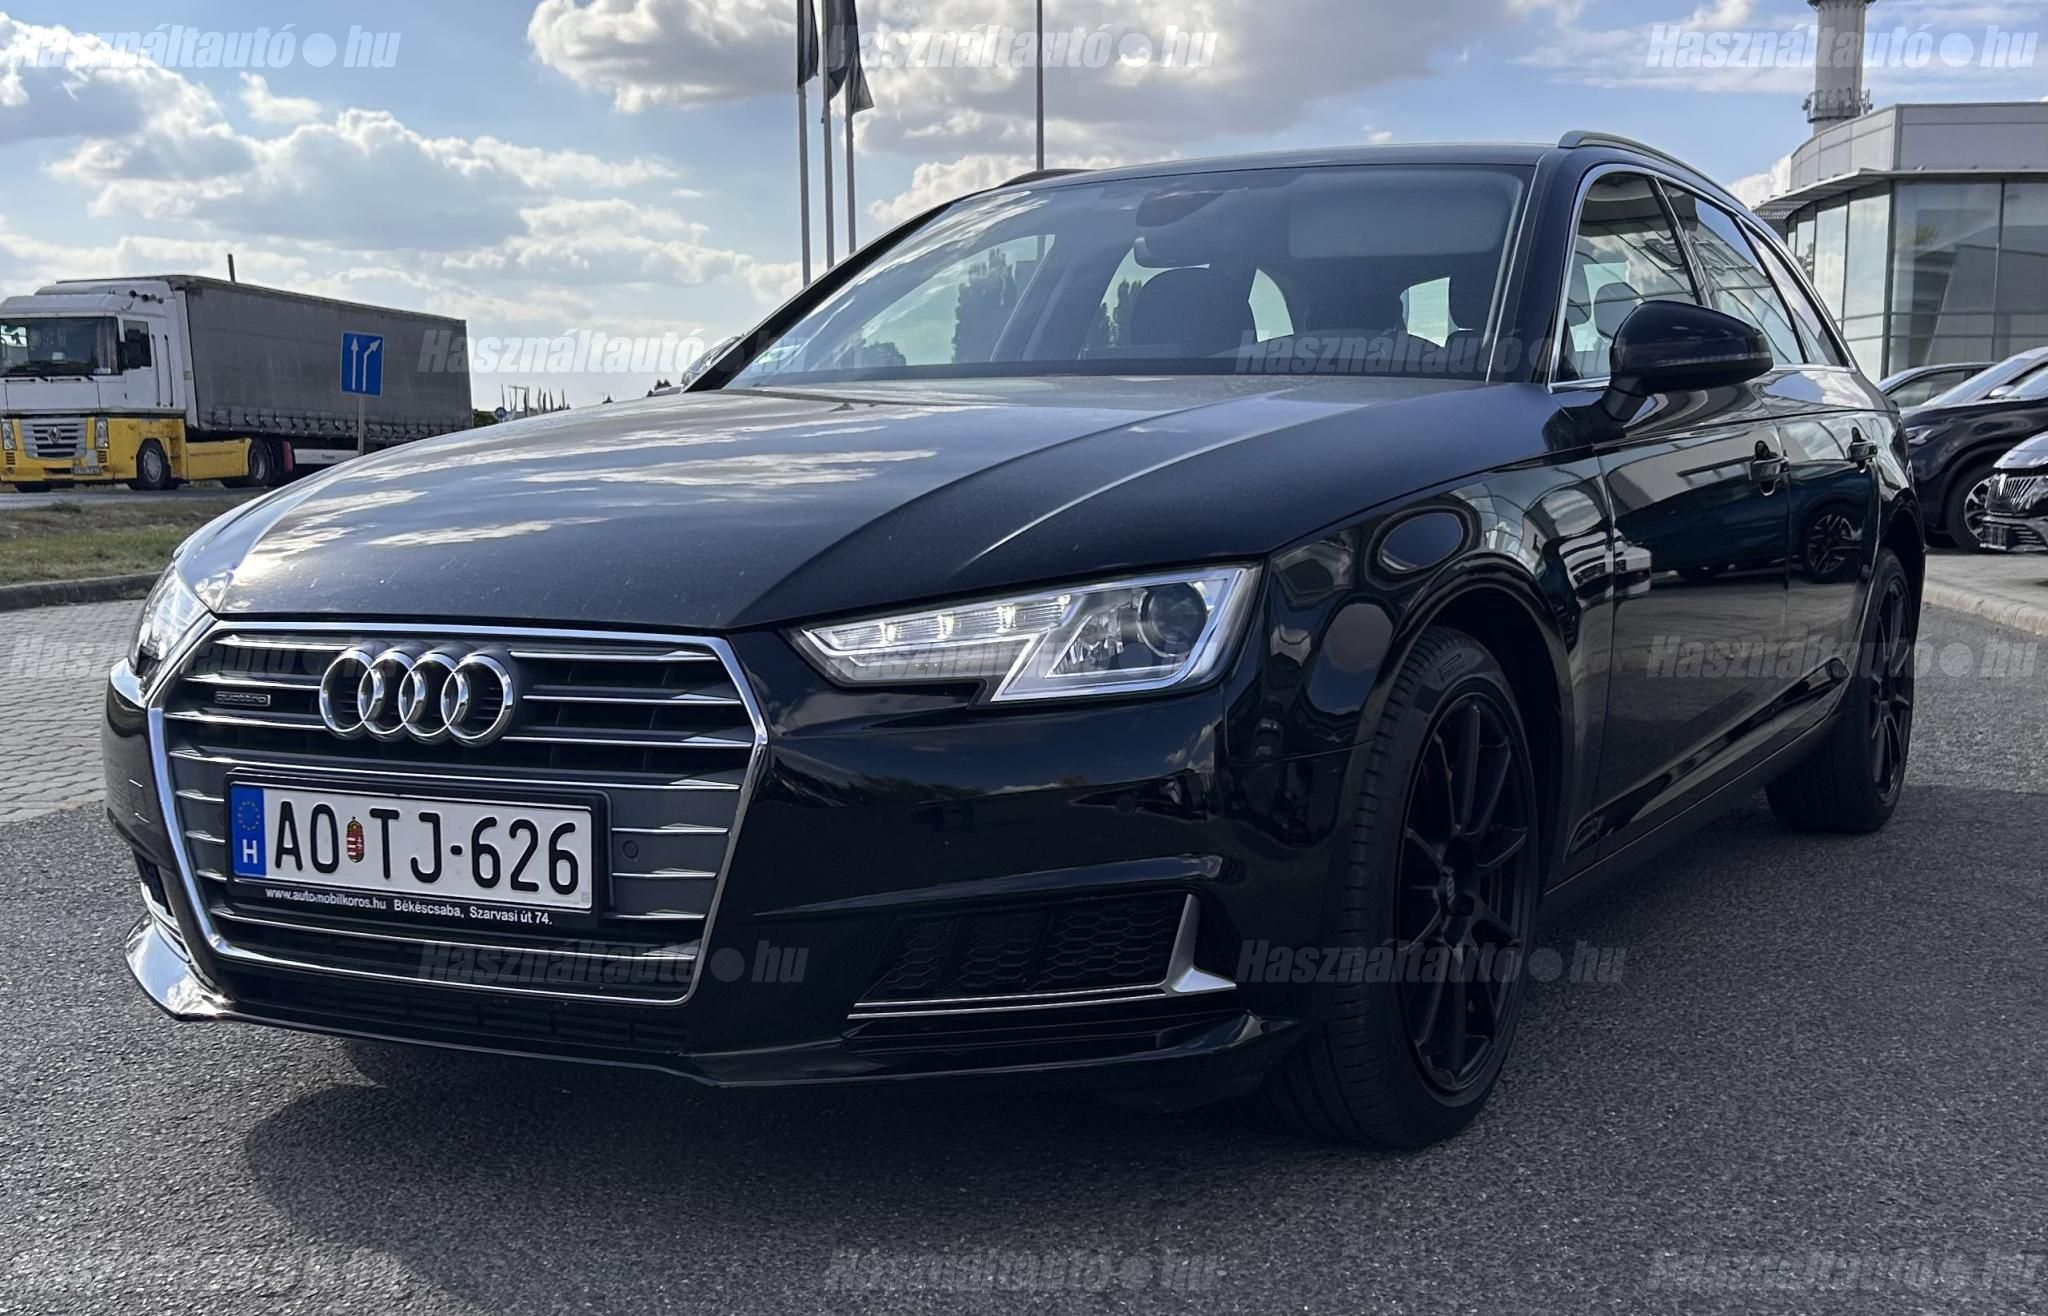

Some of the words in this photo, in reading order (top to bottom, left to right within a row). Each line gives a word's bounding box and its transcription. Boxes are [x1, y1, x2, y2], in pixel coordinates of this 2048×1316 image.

[243, 839, 258, 865] H
[393, 898, 464, 919] Békéscsaba,
[469, 905, 518, 922] Szarvasi
[520, 910, 532, 924] út
[535, 911, 553, 925] 74.
